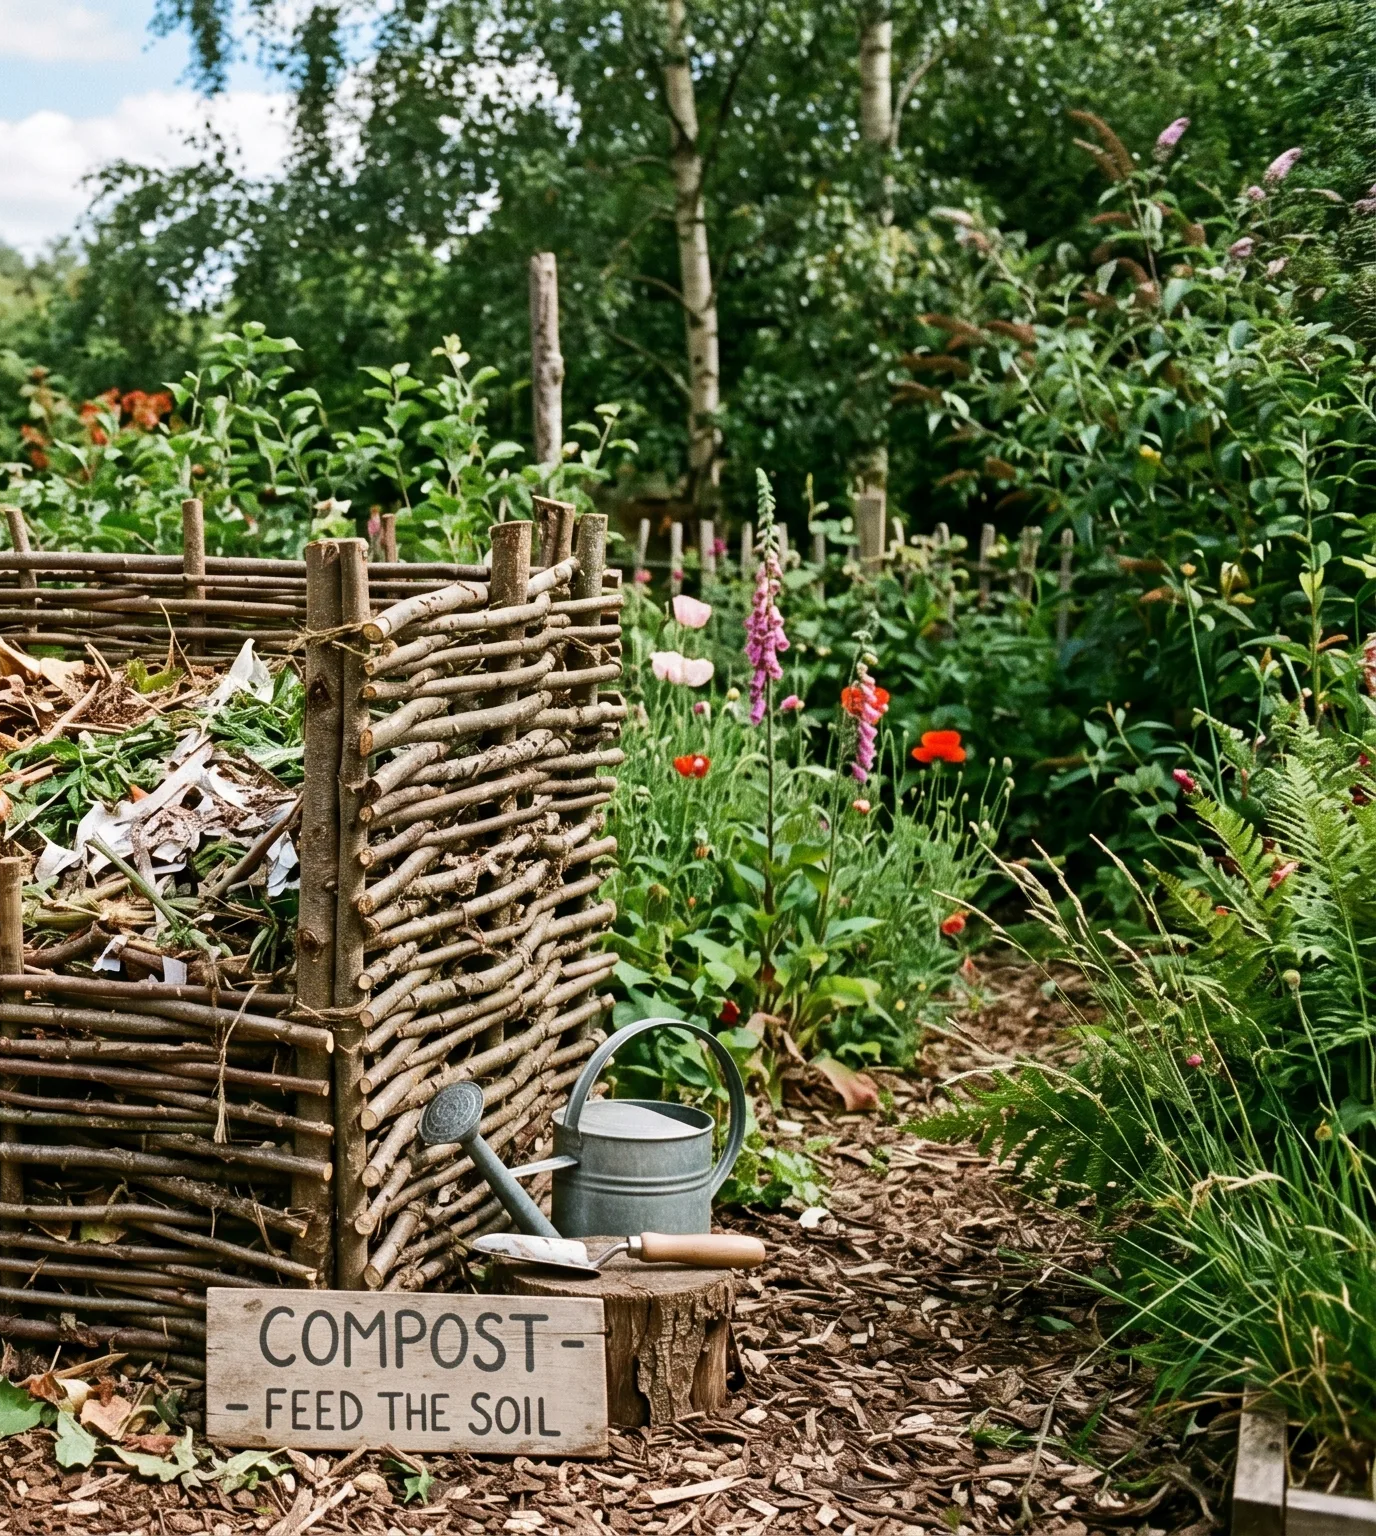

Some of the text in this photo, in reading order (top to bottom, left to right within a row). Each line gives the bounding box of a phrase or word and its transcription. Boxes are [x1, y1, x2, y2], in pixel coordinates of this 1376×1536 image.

[259, 1305, 549, 1373] COMPOST
[265, 1387, 363, 1431] FEED
[377, 1391, 451, 1432] THE
[468, 1391, 562, 1437] SOIL
